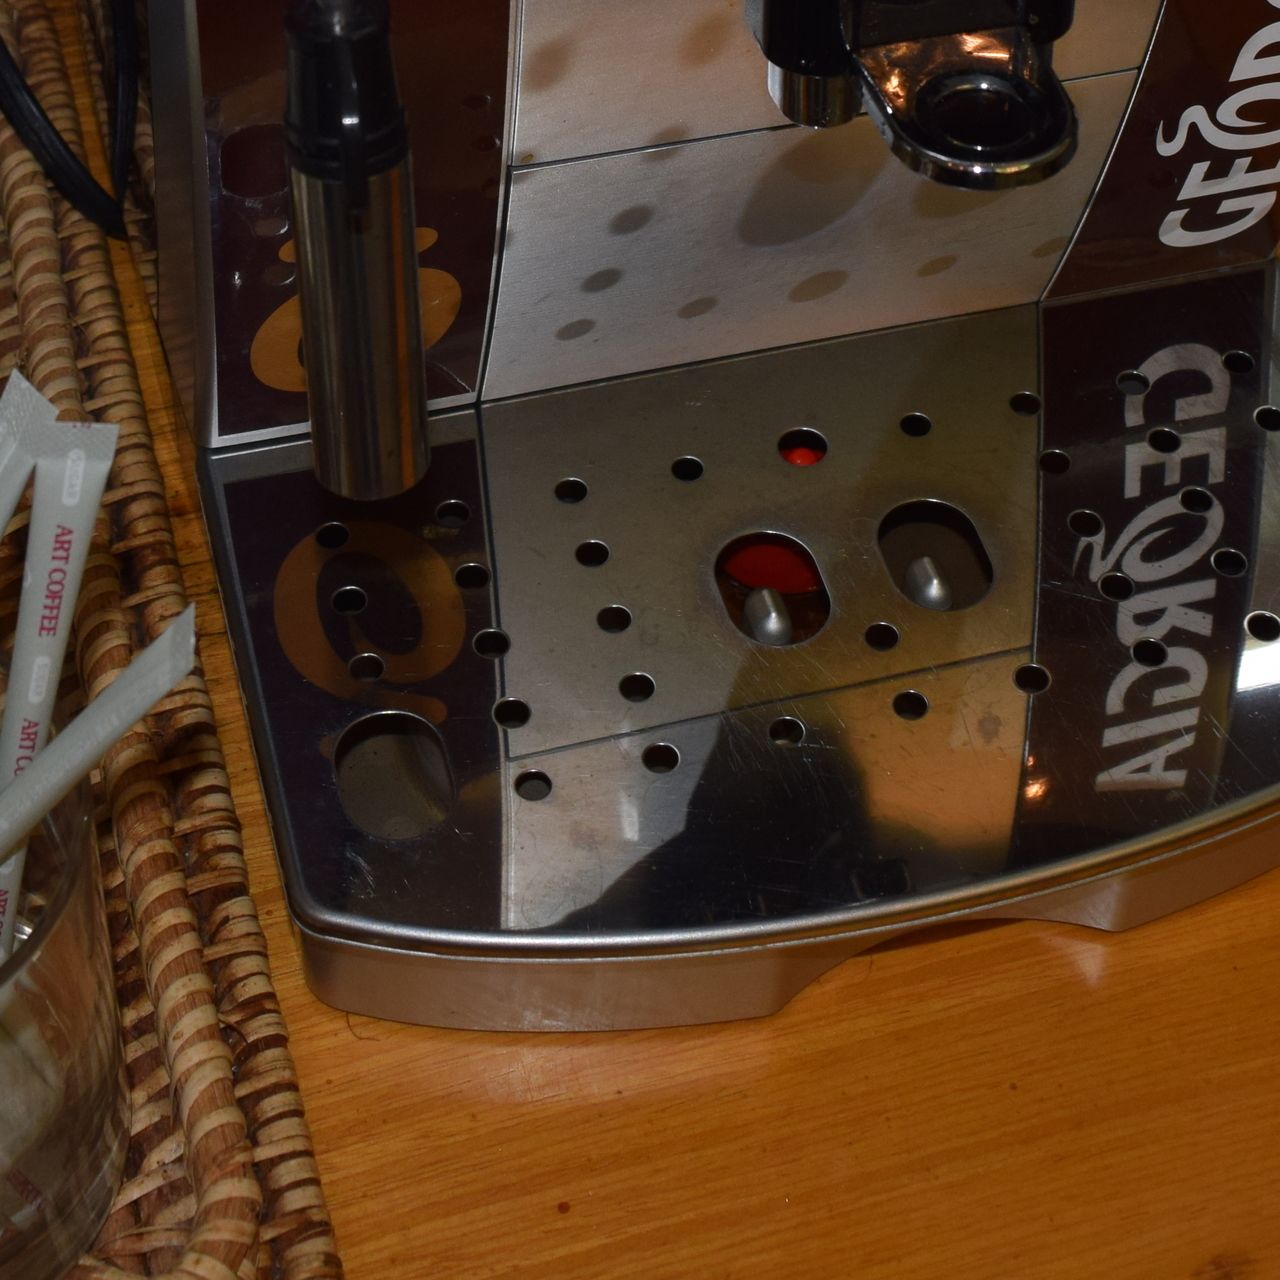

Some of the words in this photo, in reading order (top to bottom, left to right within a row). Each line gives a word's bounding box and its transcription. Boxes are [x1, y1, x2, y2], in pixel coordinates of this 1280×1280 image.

[44, 524, 74, 567] ART
[38, 568, 67, 638] COFFEE
[19, 716, 39, 756] ART
